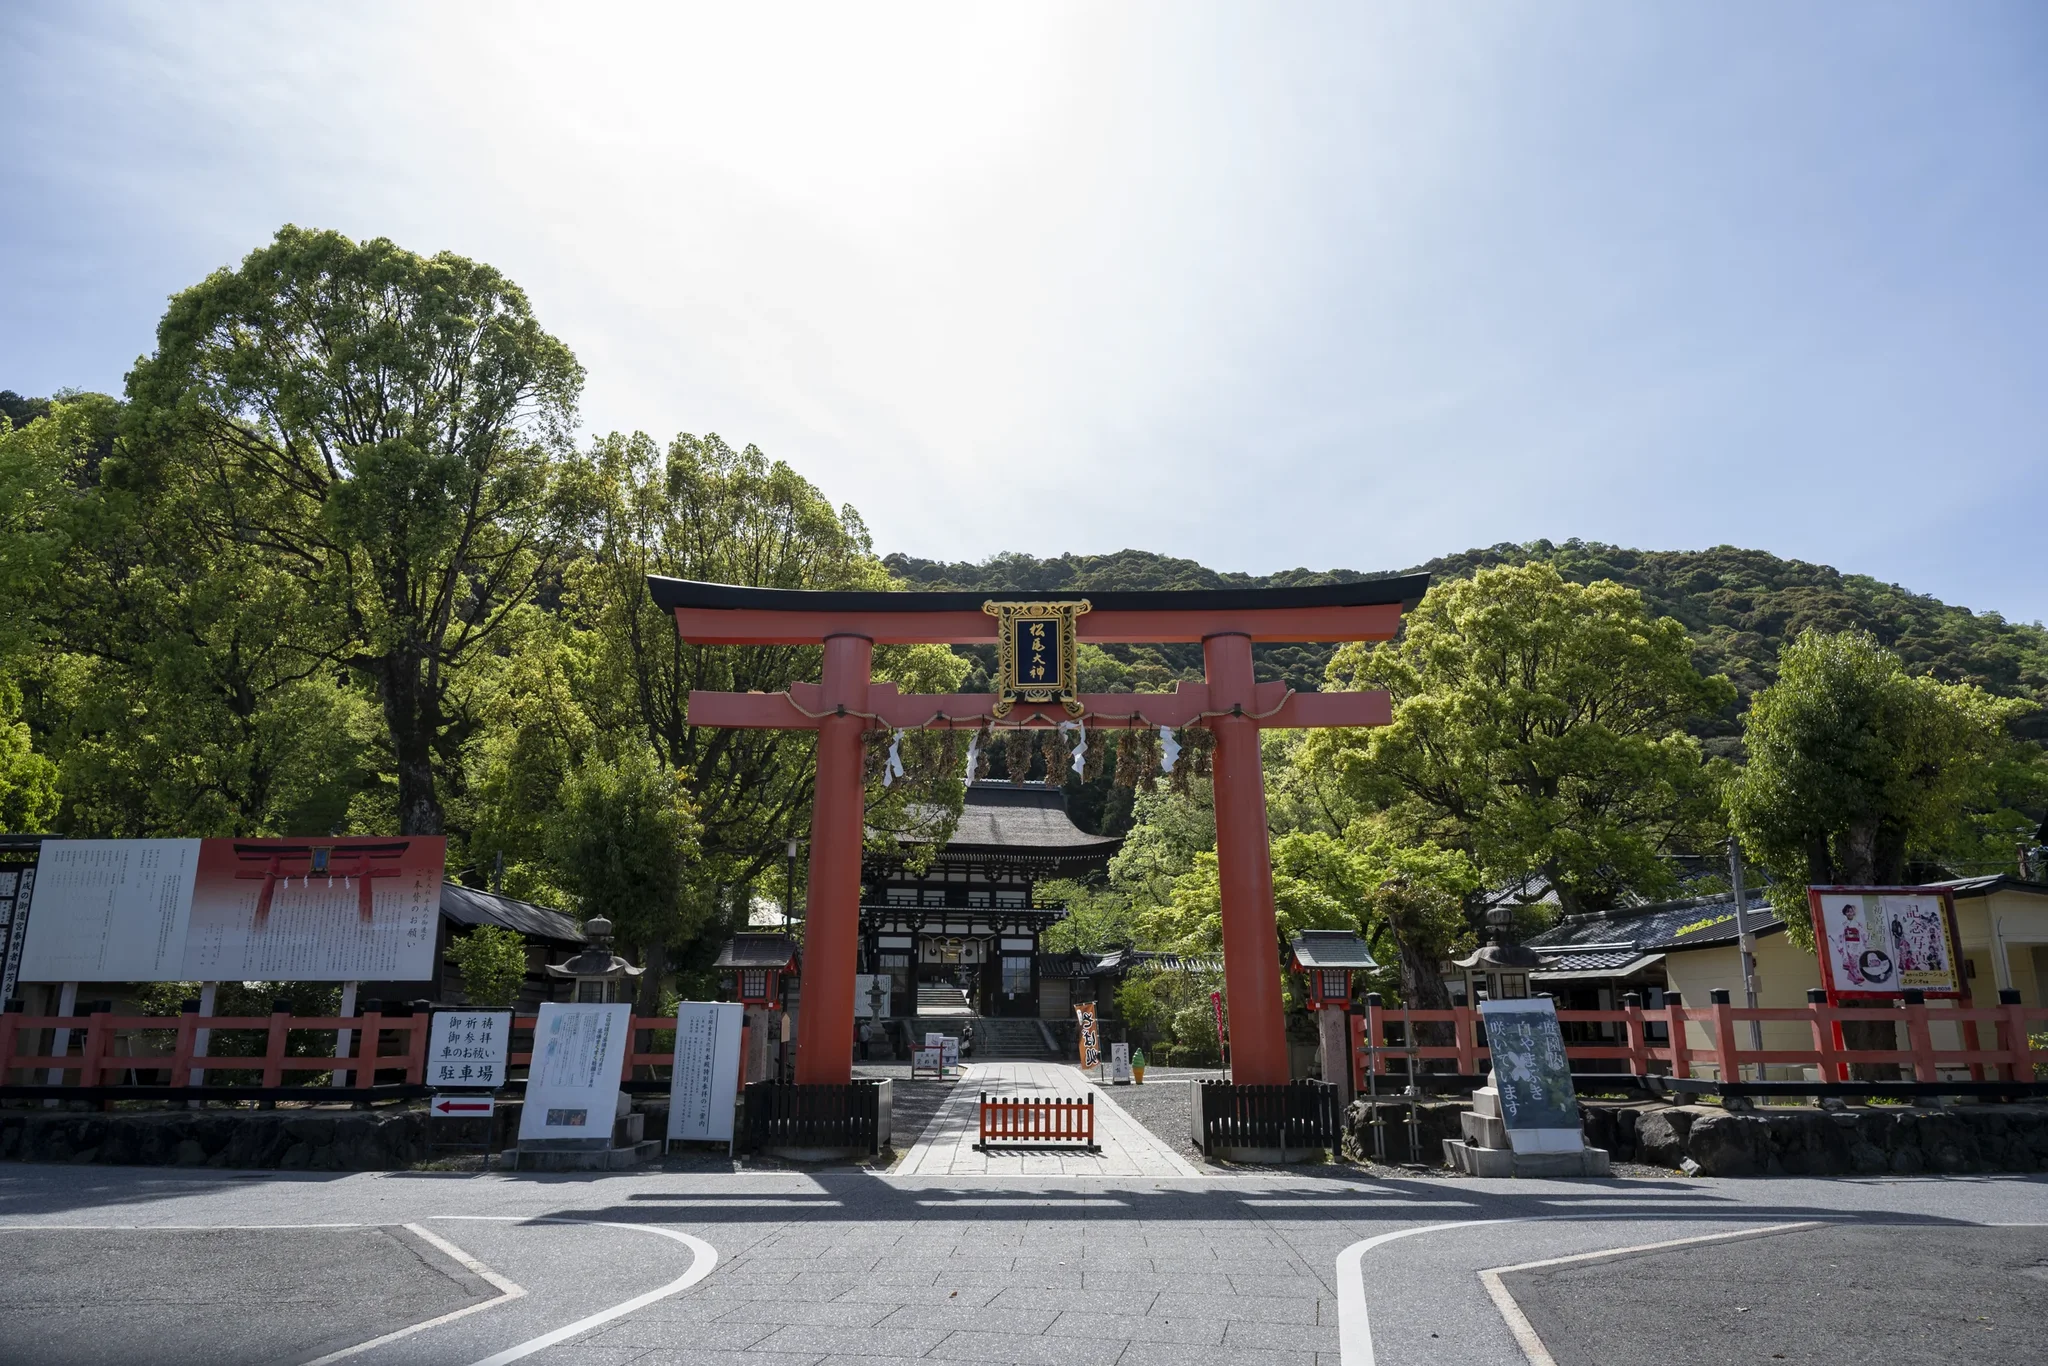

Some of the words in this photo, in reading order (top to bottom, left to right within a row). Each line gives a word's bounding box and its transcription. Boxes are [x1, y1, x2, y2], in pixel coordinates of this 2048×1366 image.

[1029, 623, 1046, 680] 松尾大神
[4, 871, 34, 1000] 平成の御遷宮奉賛者御芳名
[1906, 904, 1928, 967] 記念写真
[448, 1031, 492, 1044] 御参拝
[449, 1016, 493, 1030] 御祈祷
[1543, 1020, 1564, 1070] 庭園内
[439, 1065, 494, 1082] 駐車場
[441, 1046, 495, 1059] 車のお祓い
[1490, 1020, 1520, 1117] 咲いています
[1518, 1020, 1543, 1101] 白やまぶき
